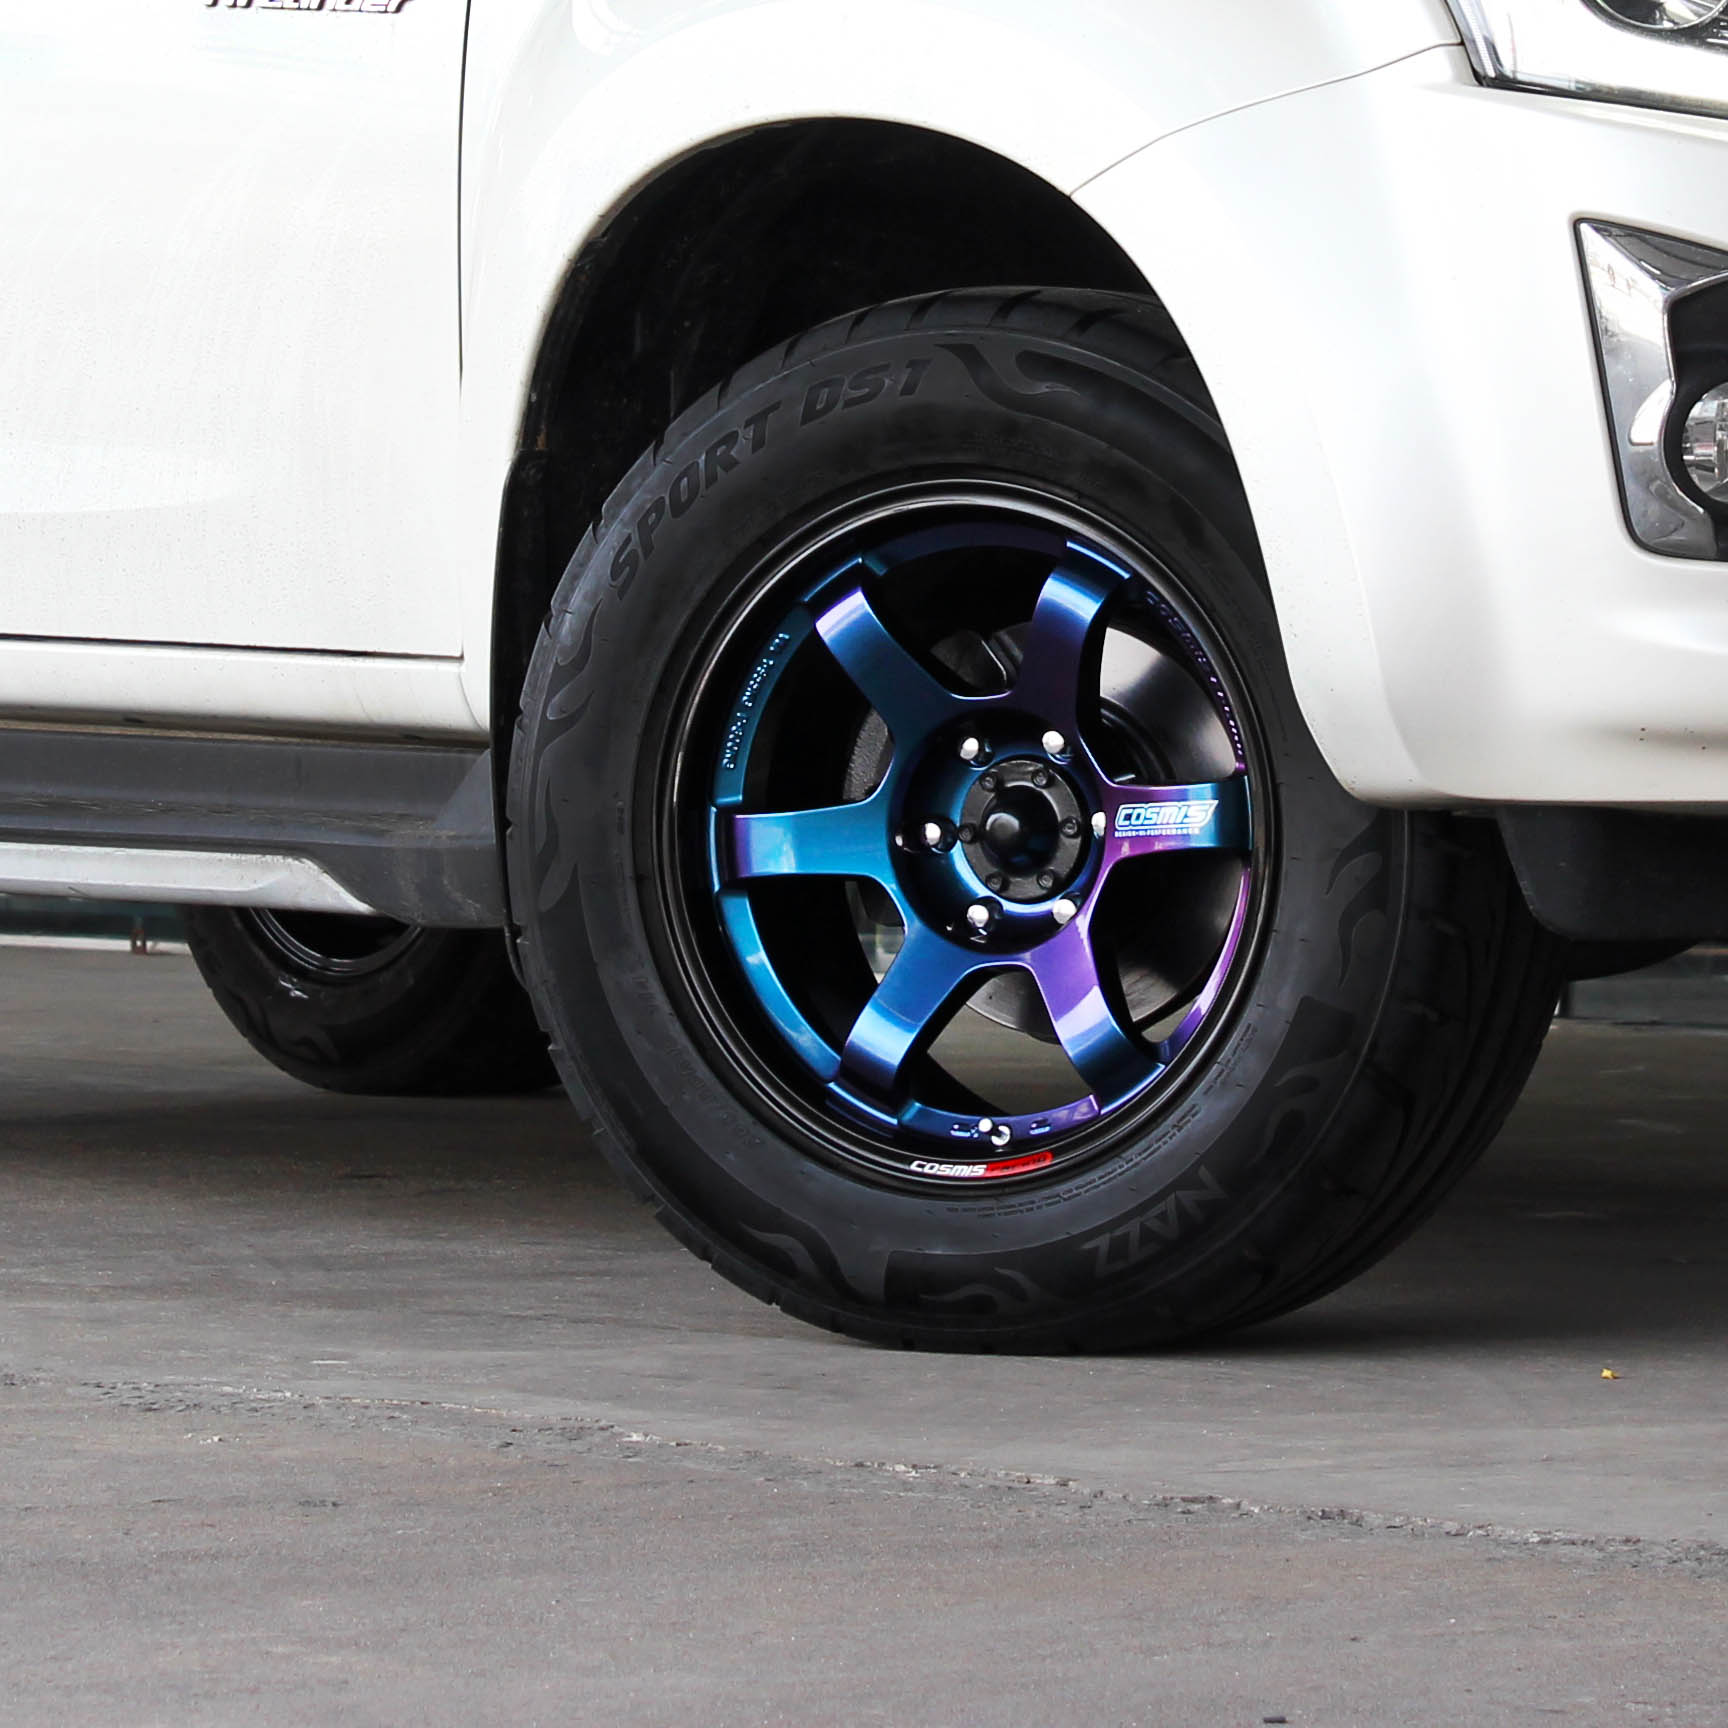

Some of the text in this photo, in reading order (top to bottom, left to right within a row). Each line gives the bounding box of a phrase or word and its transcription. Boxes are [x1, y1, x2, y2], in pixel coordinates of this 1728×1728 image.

[608, 358, 934, 602] SPORT DS1
[1117, 802, 1212, 827] COSMIS
[910, 1160, 988, 1177] COSMIS
